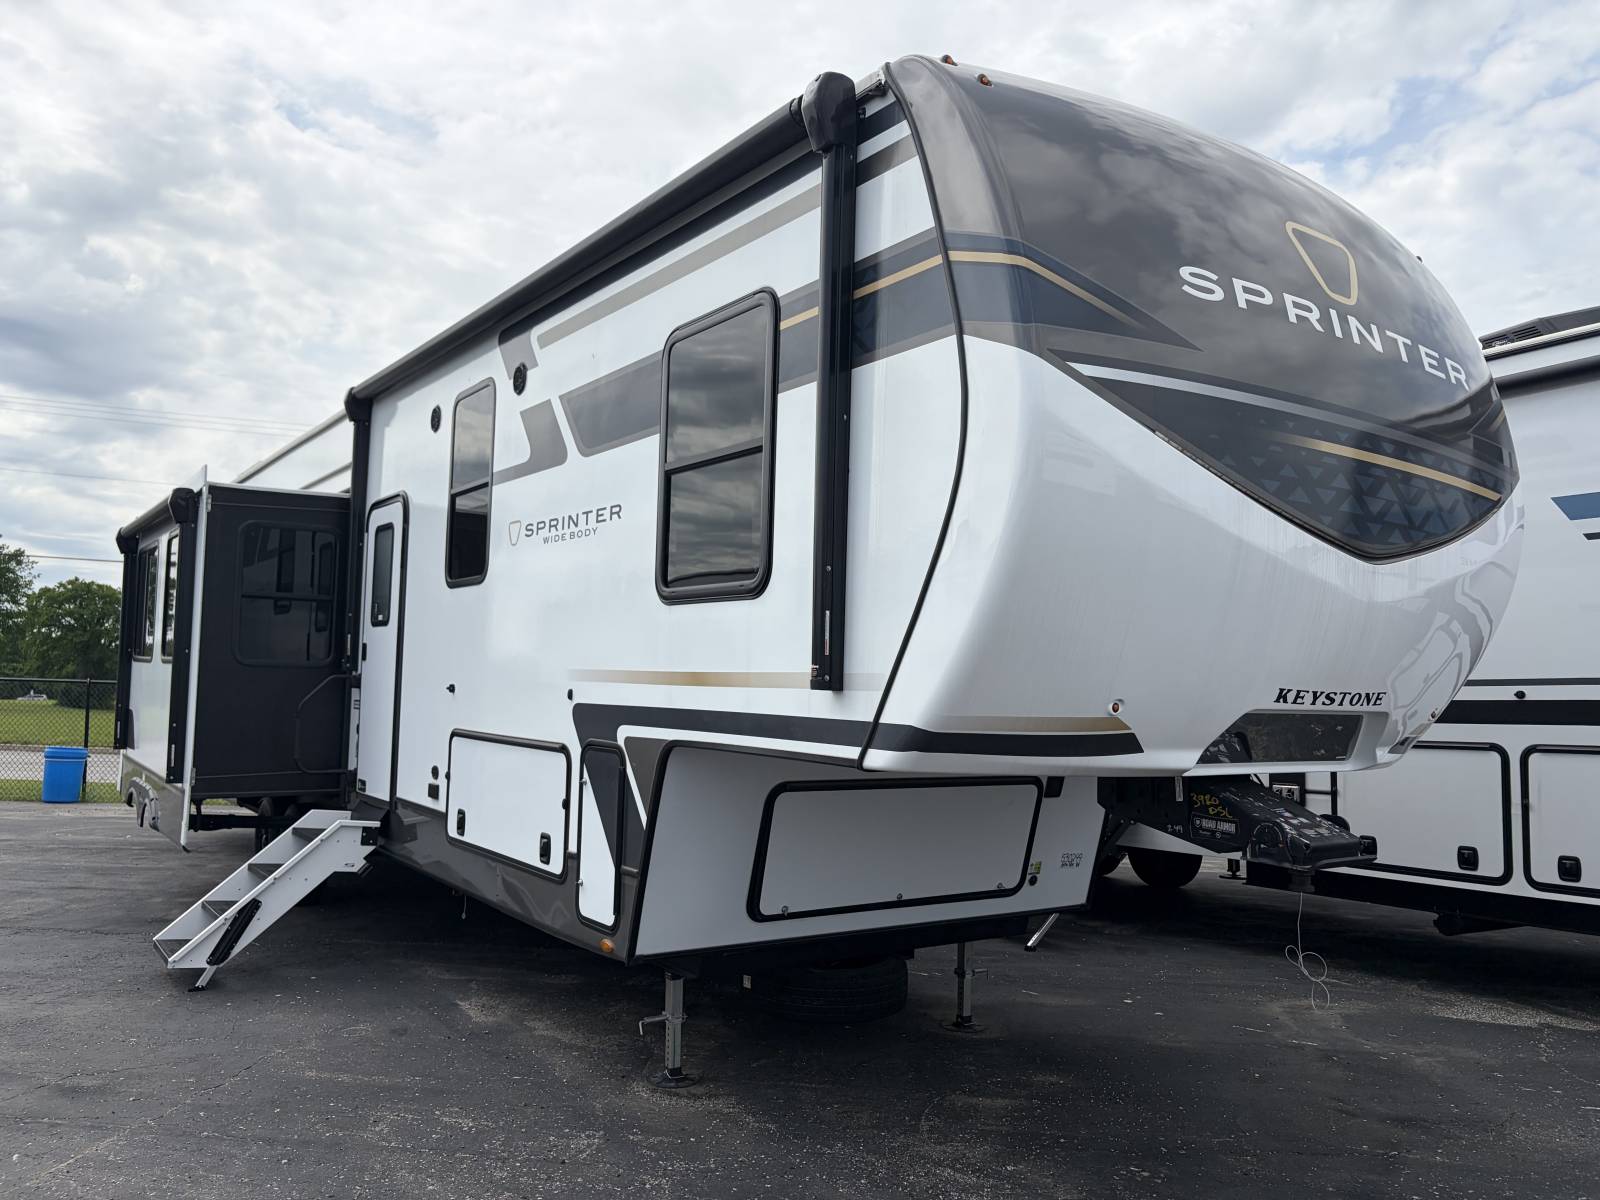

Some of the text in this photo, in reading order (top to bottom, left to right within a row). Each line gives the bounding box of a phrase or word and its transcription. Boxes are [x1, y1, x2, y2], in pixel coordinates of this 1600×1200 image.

[1179, 265, 1471, 392] SPRINTER
[524, 504, 622, 537] SPRINTER
[543, 527, 598, 544] WIDE BODY
[1273, 687, 1387, 706] KEYSTONE
